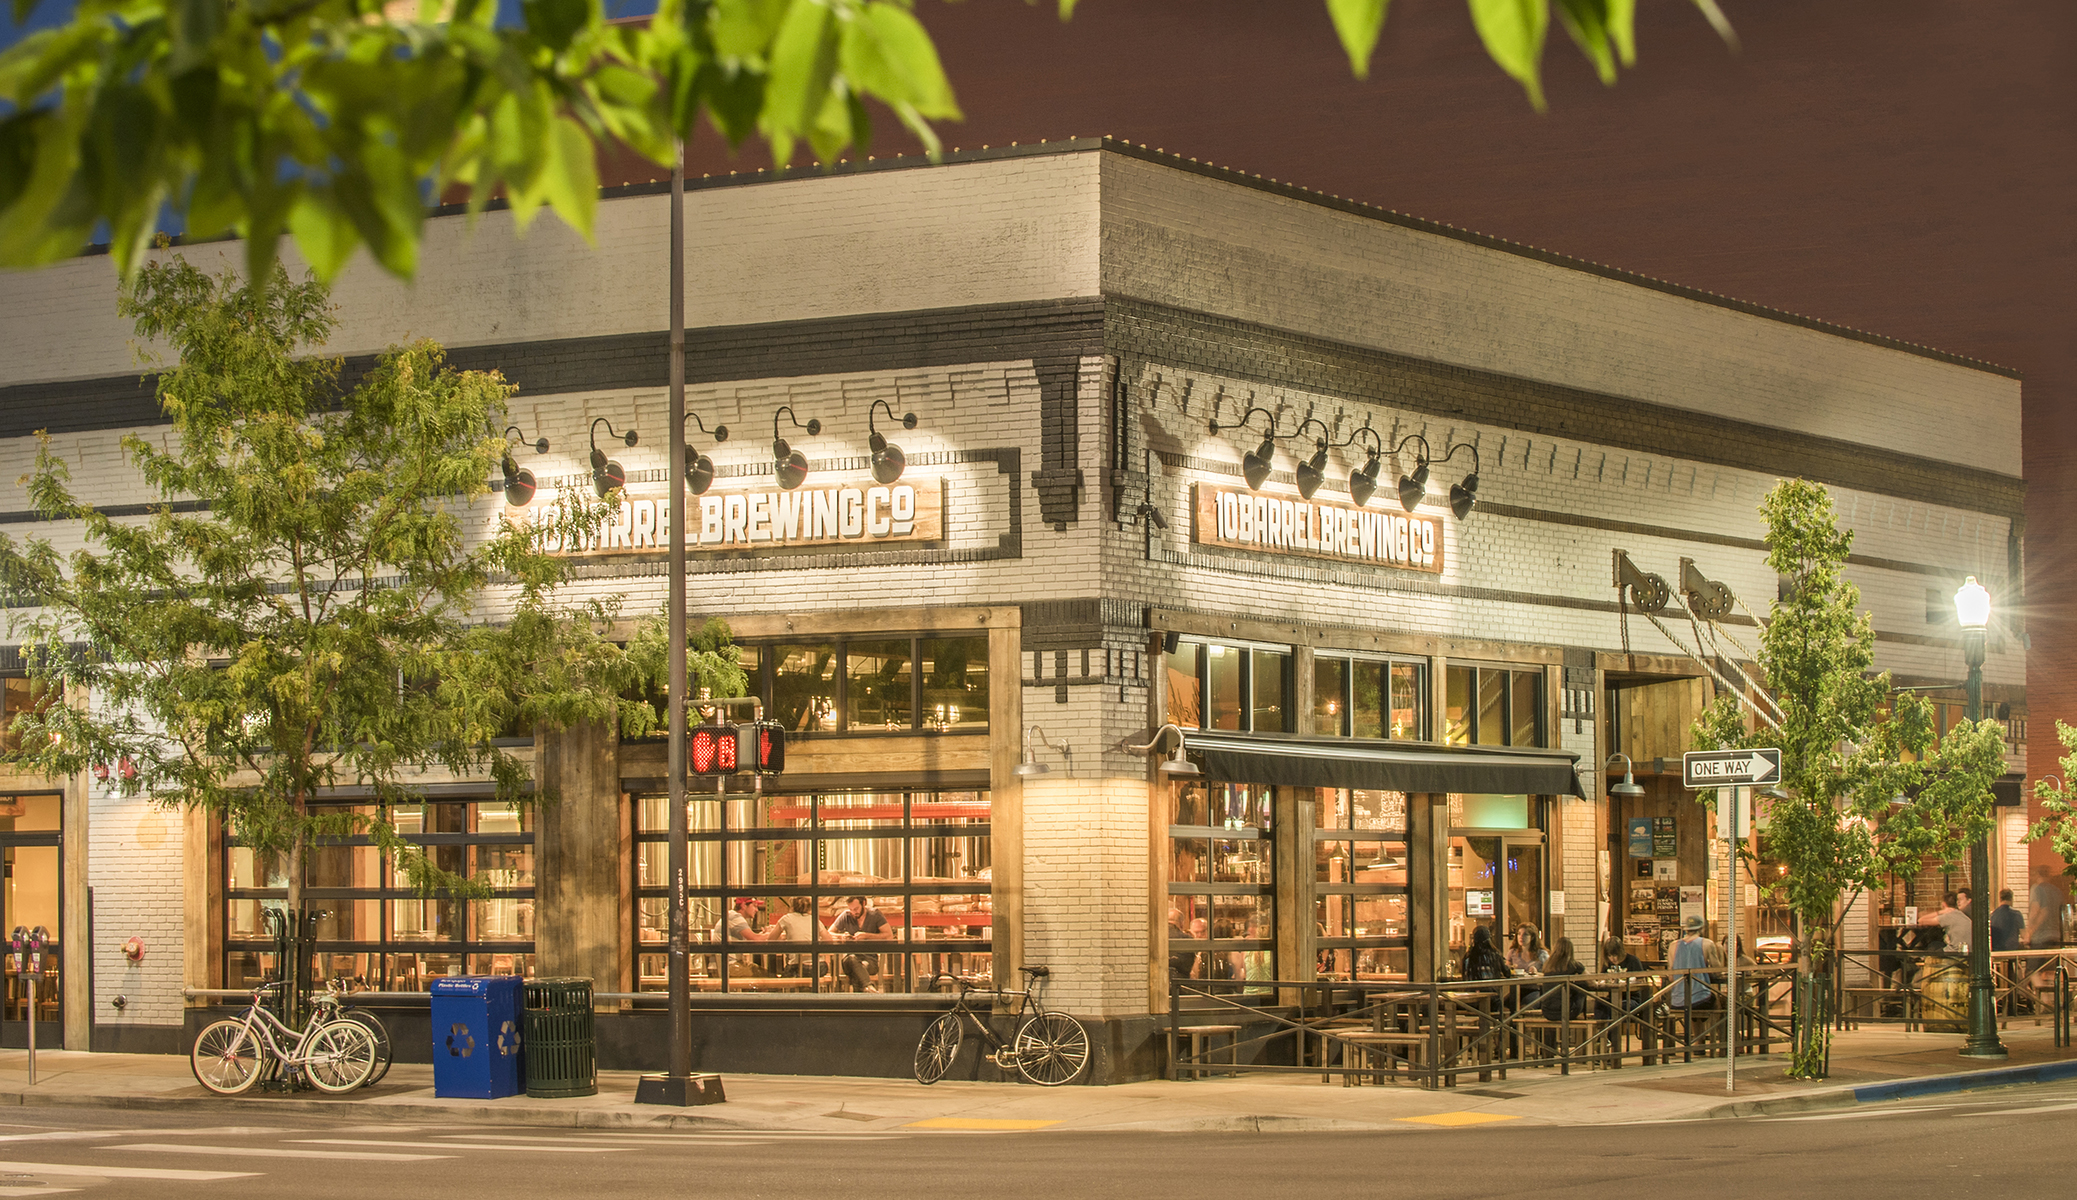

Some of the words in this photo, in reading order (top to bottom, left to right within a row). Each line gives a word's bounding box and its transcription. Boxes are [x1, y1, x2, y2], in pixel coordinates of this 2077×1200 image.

[700, 488, 863, 544] BREWING
[1215, 491, 1239, 542] 10
[1238, 494, 1320, 552] BARREL
[1320, 505, 1408, 563] BREWING
[1694, 761, 1720, 776] ONE
[1724, 760, 1751, 774] WAY
